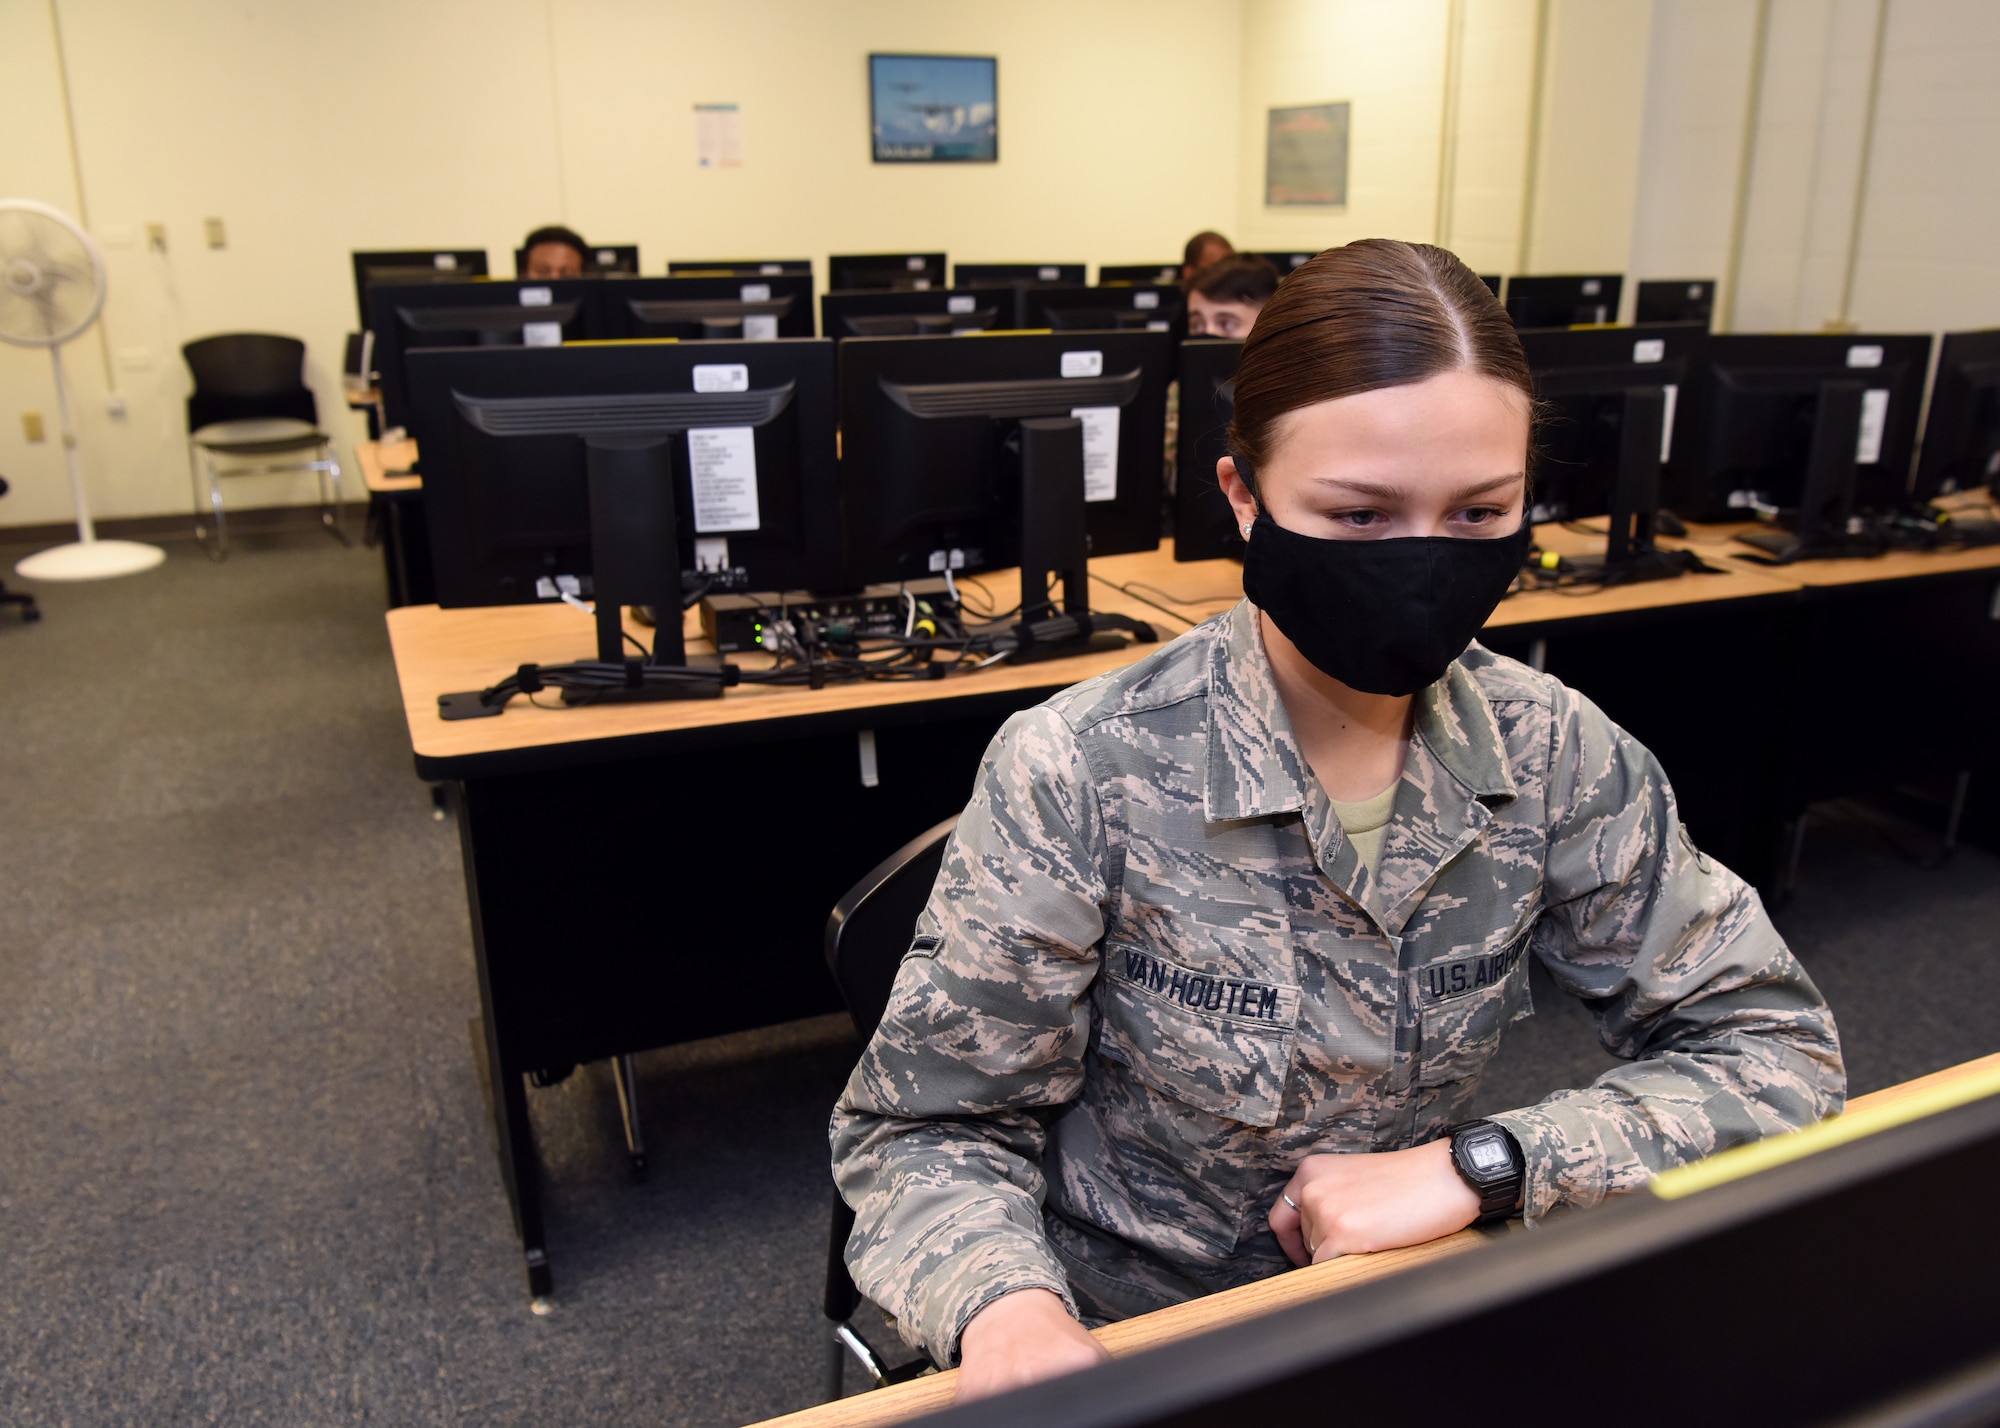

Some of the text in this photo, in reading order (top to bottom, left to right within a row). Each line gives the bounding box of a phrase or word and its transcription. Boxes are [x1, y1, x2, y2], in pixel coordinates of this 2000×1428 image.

[1125, 950, 1278, 1019] VAN HOUTEM
[1430, 964, 1472, 998] U.S.
